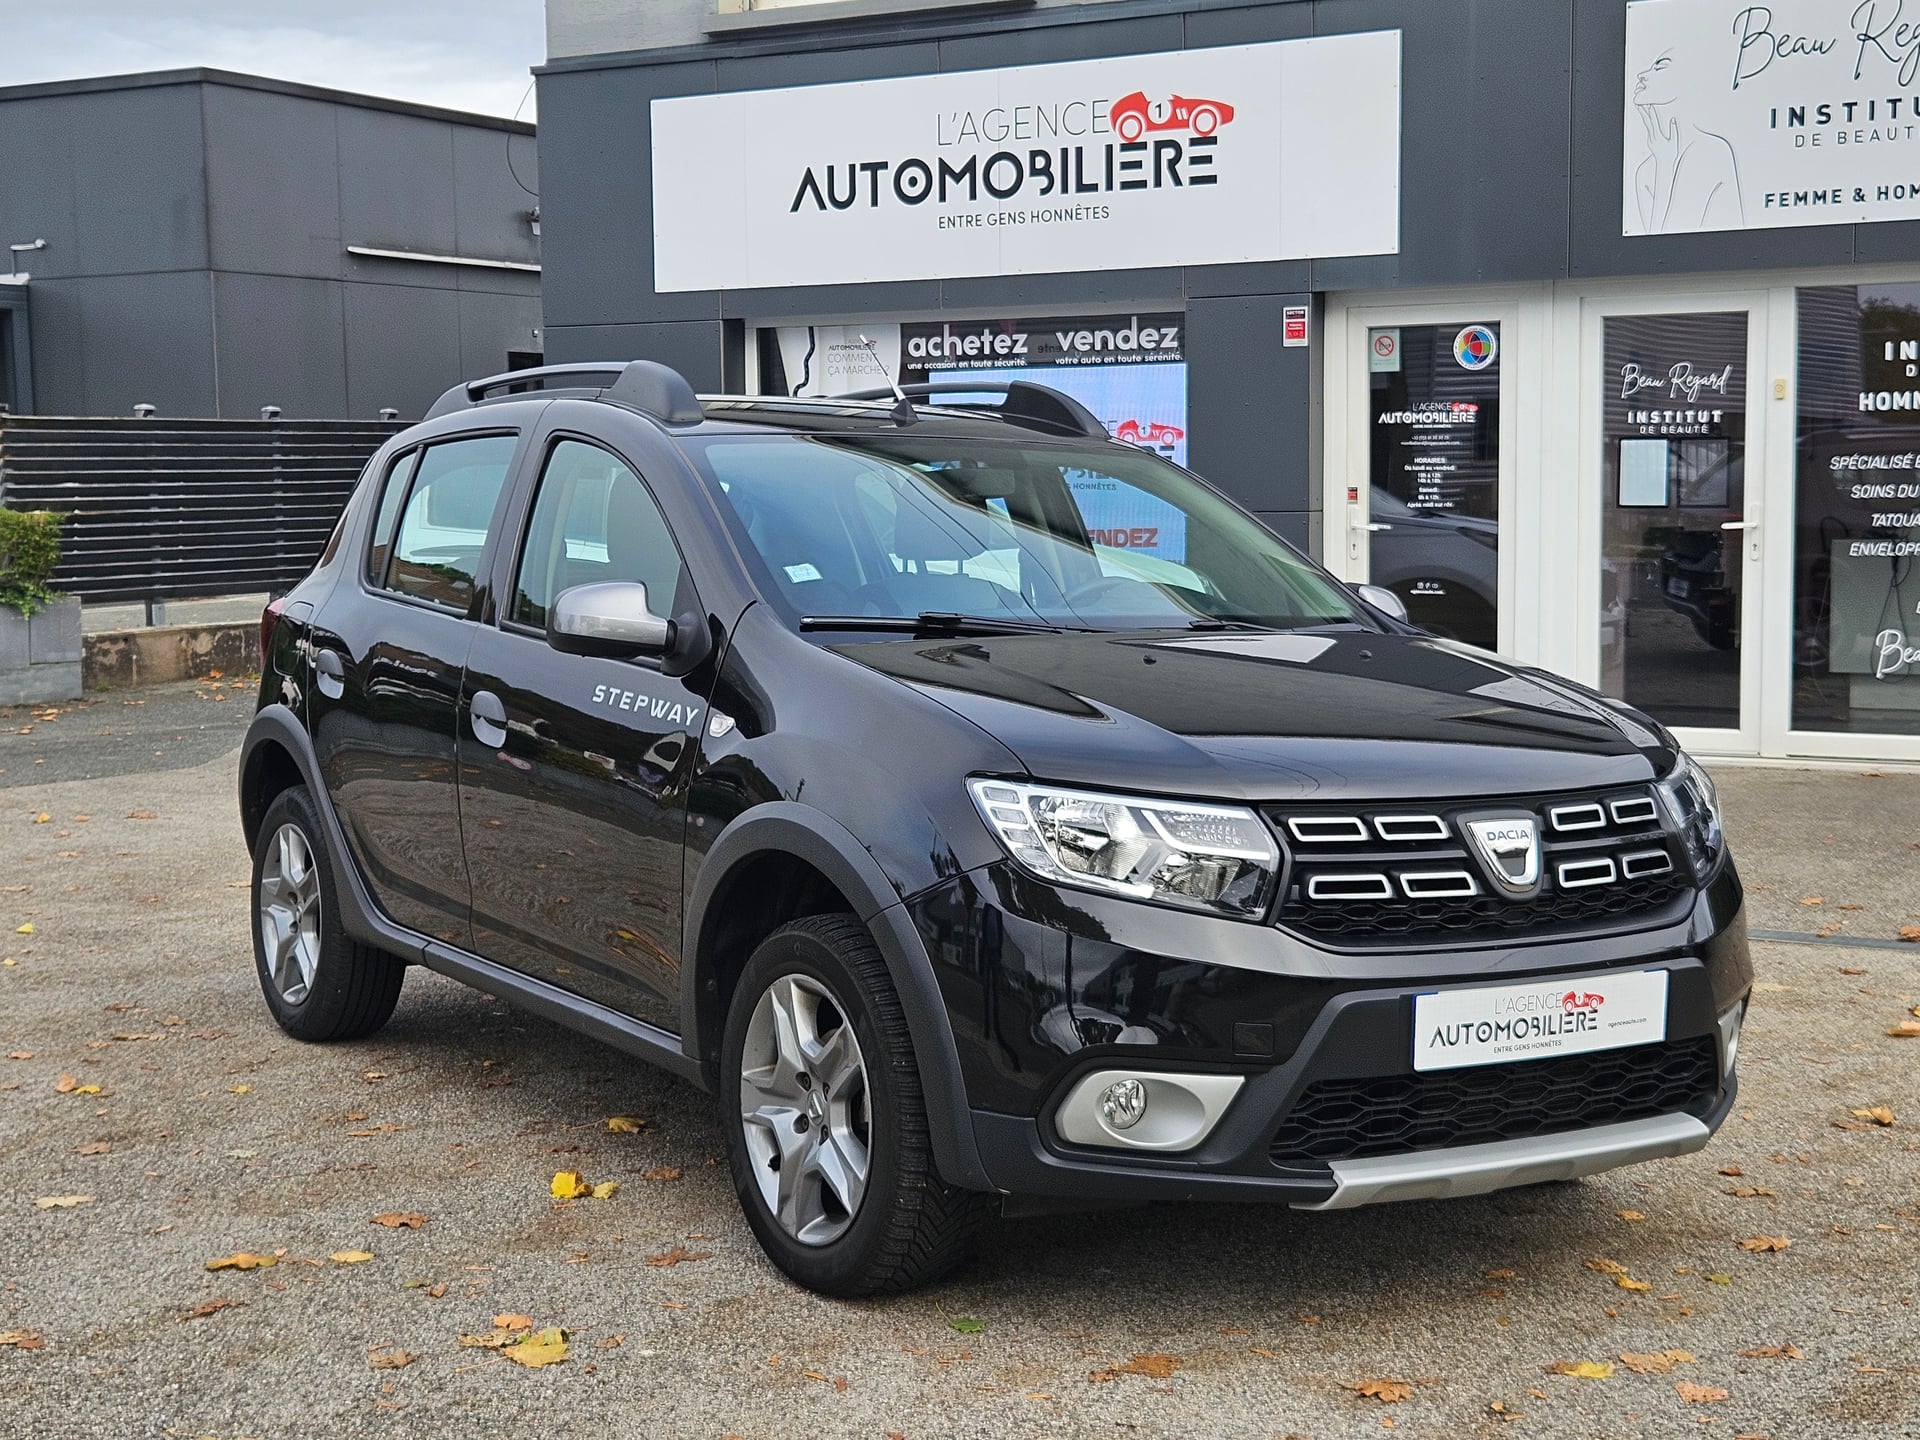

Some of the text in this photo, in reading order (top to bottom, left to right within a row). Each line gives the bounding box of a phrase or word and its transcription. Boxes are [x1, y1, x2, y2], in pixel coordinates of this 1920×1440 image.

[1733, 7, 1837, 91] Beau
[938, 100, 1109, 146] L'AGENCE
[1795, 133, 1821, 148] DE
[1765, 189, 1842, 208] FEMME
[1852, 187, 1866, 203] &
[938, 203, 1110, 229] ENTRE GENS HONNÊTES
[907, 324, 1028, 358] achetez
[1055, 316, 1178, 352] vendez
[1884, 340, 1919, 361] IN
[924, 360, 956, 370] occasion
[970, 360, 992, 368] toute
[1055, 356, 1078, 365] votre
[1080, 356, 1101, 365] auto
[1117, 354, 1141, 363] toute
[827, 365, 842, 377] ÇA
[1620, 361, 1733, 403] Beau Regard
[1412, 402, 1452, 411] L'AGENCE
[1627, 410, 1723, 424] INSTITUT
[1640, 423, 1710, 434] DE BEAUTÉ
[1829, 451, 1915, 470] SPÉCIALISÉ
[1072, 482, 1117, 491] HONNÊTES
[1850, 484, 1920, 498] SOINS DU
[1871, 512, 1920, 528] TATOUA
[1087, 528, 1158, 548] ENDEZ
[592, 684, 699, 726] STEPWAY
[1486, 829, 1530, 841] DACIA
[1494, 992, 1563, 1015] L'AGENCE
[1493, 1039, 1562, 1054] ENTRE GENS HONNÊTES
